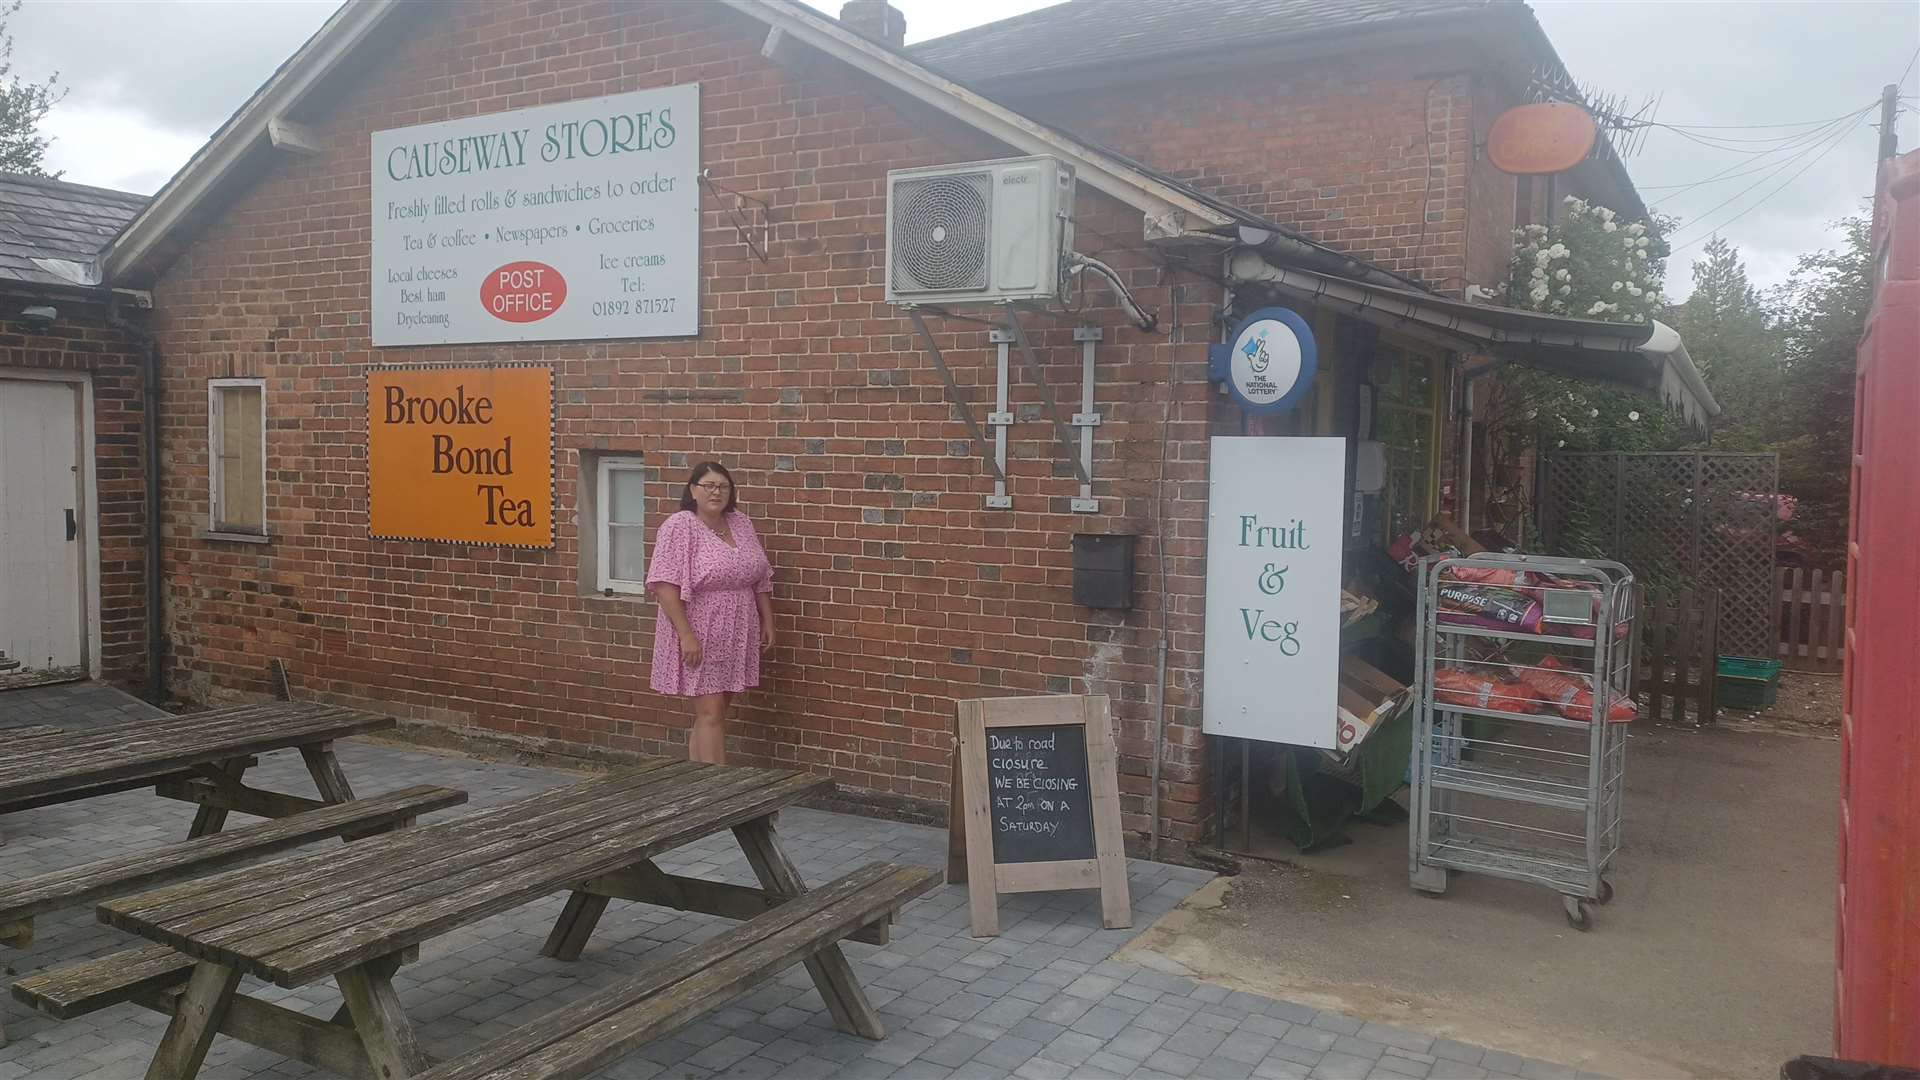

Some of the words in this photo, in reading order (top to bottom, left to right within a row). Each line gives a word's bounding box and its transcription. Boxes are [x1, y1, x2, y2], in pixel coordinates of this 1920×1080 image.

[388, 129, 530, 181] CAUSEWAY
[541, 107, 676, 162] STORES
[388, 198, 430, 223] Freshly
[435, 193, 466, 215] filled
[471, 191, 500, 211] rolls
[505, 189, 518, 208] &
[522, 181, 600, 206] sandwiches
[607, 180, 624, 198] to
[630, 172, 677, 196] order
[496, 225, 568, 246] Newspapers
[588, 216, 655, 235] Groceries
[403, 235, 423, 251] Tea
[427, 233, 438, 249] &
[441, 228, 477, 247] coffee
[600, 254, 619, 270] Ice
[624, 254, 666, 268] creams
[388, 266, 413, 283] Local
[416, 266, 458, 281] cheeses
[499, 269, 545, 289] POST
[621, 277, 646, 293] Tel:
[400, 289, 423, 304] Best
[427, 287, 446, 302] ham
[493, 292, 553, 313] OFFICE
[592, 301, 630, 317] 01892
[635, 298, 676, 314] 871527
[397, 311, 450, 329] Drycleaning
[384, 384, 493, 425] Brooke
[432, 434, 514, 476] Bond
[477, 484, 536, 528] Tea
[1238, 514, 1311, 550] Fruit
[1258, 562, 1289, 595] &
[1440, 588, 1489, 608] PURPOSE
[1240, 608, 1301, 657] Veg
[989, 734, 1012, 750] Due
[1012, 736, 1024, 751] to
[1028, 731, 1055, 751] road
[995, 776, 1013, 789] WE
[1016, 778, 1031, 789] BE
[1033, 778, 1079, 791] CLOSING
[997, 796, 1014, 809] AT
[1040, 800, 1055, 811] ON
[1060, 800, 1071, 811] A
